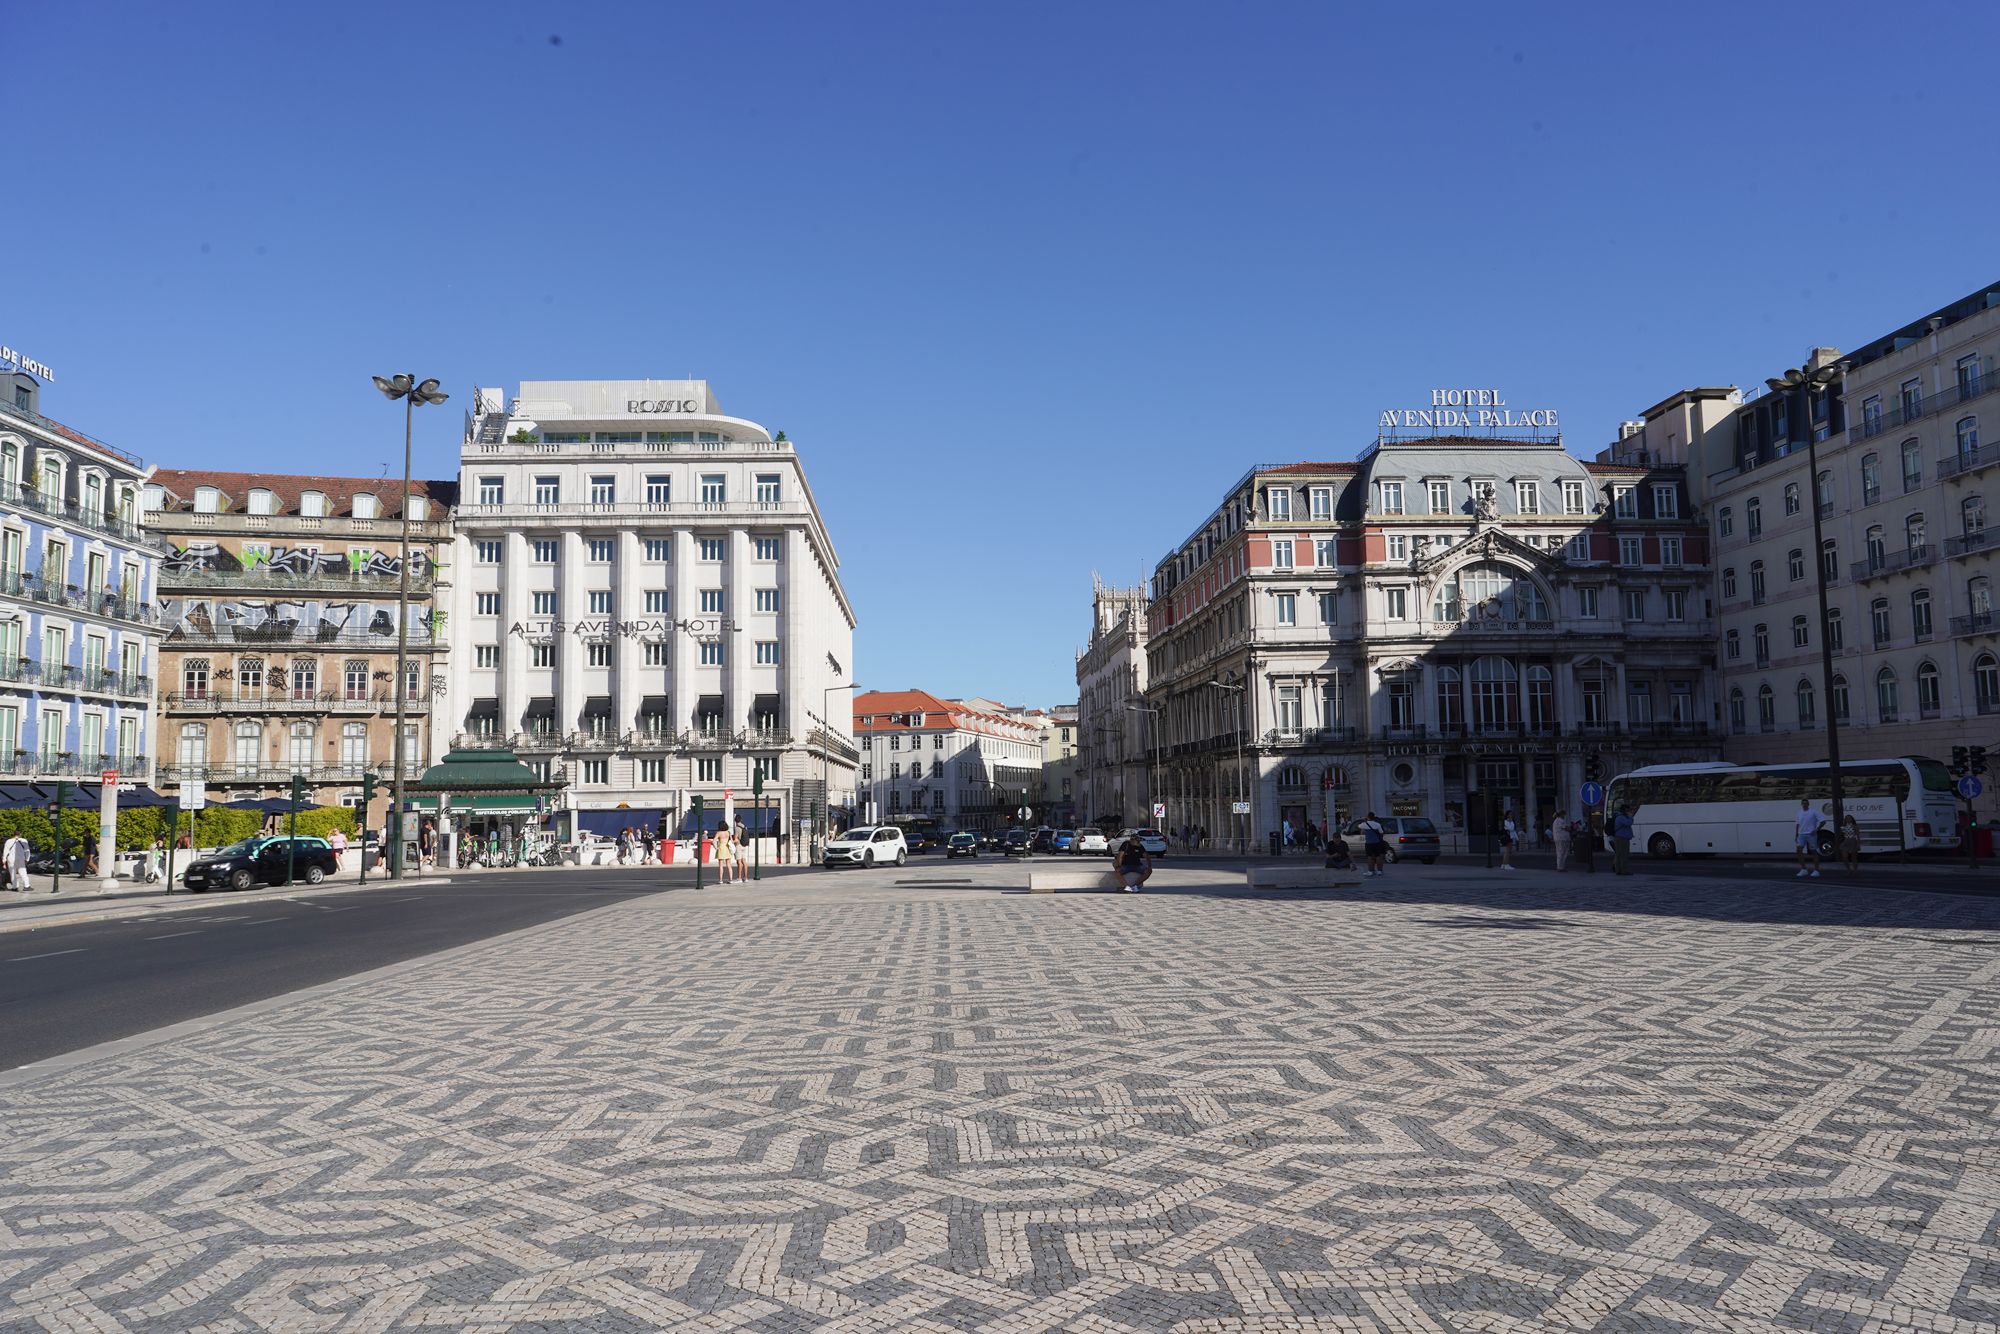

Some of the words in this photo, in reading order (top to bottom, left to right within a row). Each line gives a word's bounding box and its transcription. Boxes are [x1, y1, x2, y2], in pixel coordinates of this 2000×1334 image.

[21, 355, 54, 383] HOTEL
[1431, 389, 1505, 406] HOTEL
[628, 400, 698, 413] ROSSIO
[1379, 410, 1472, 427] AVENIDA
[1477, 410, 1558, 426] PALACE
[509, 621, 566, 634] ALTIS
[573, 620, 664, 634] AVENIDA
[673, 618, 743, 632] HOTEL
[1387, 743, 1442, 756] HOTEL
[1460, 743, 1539, 754] AVENIDA
[1556, 742, 1619, 753] PALACE
